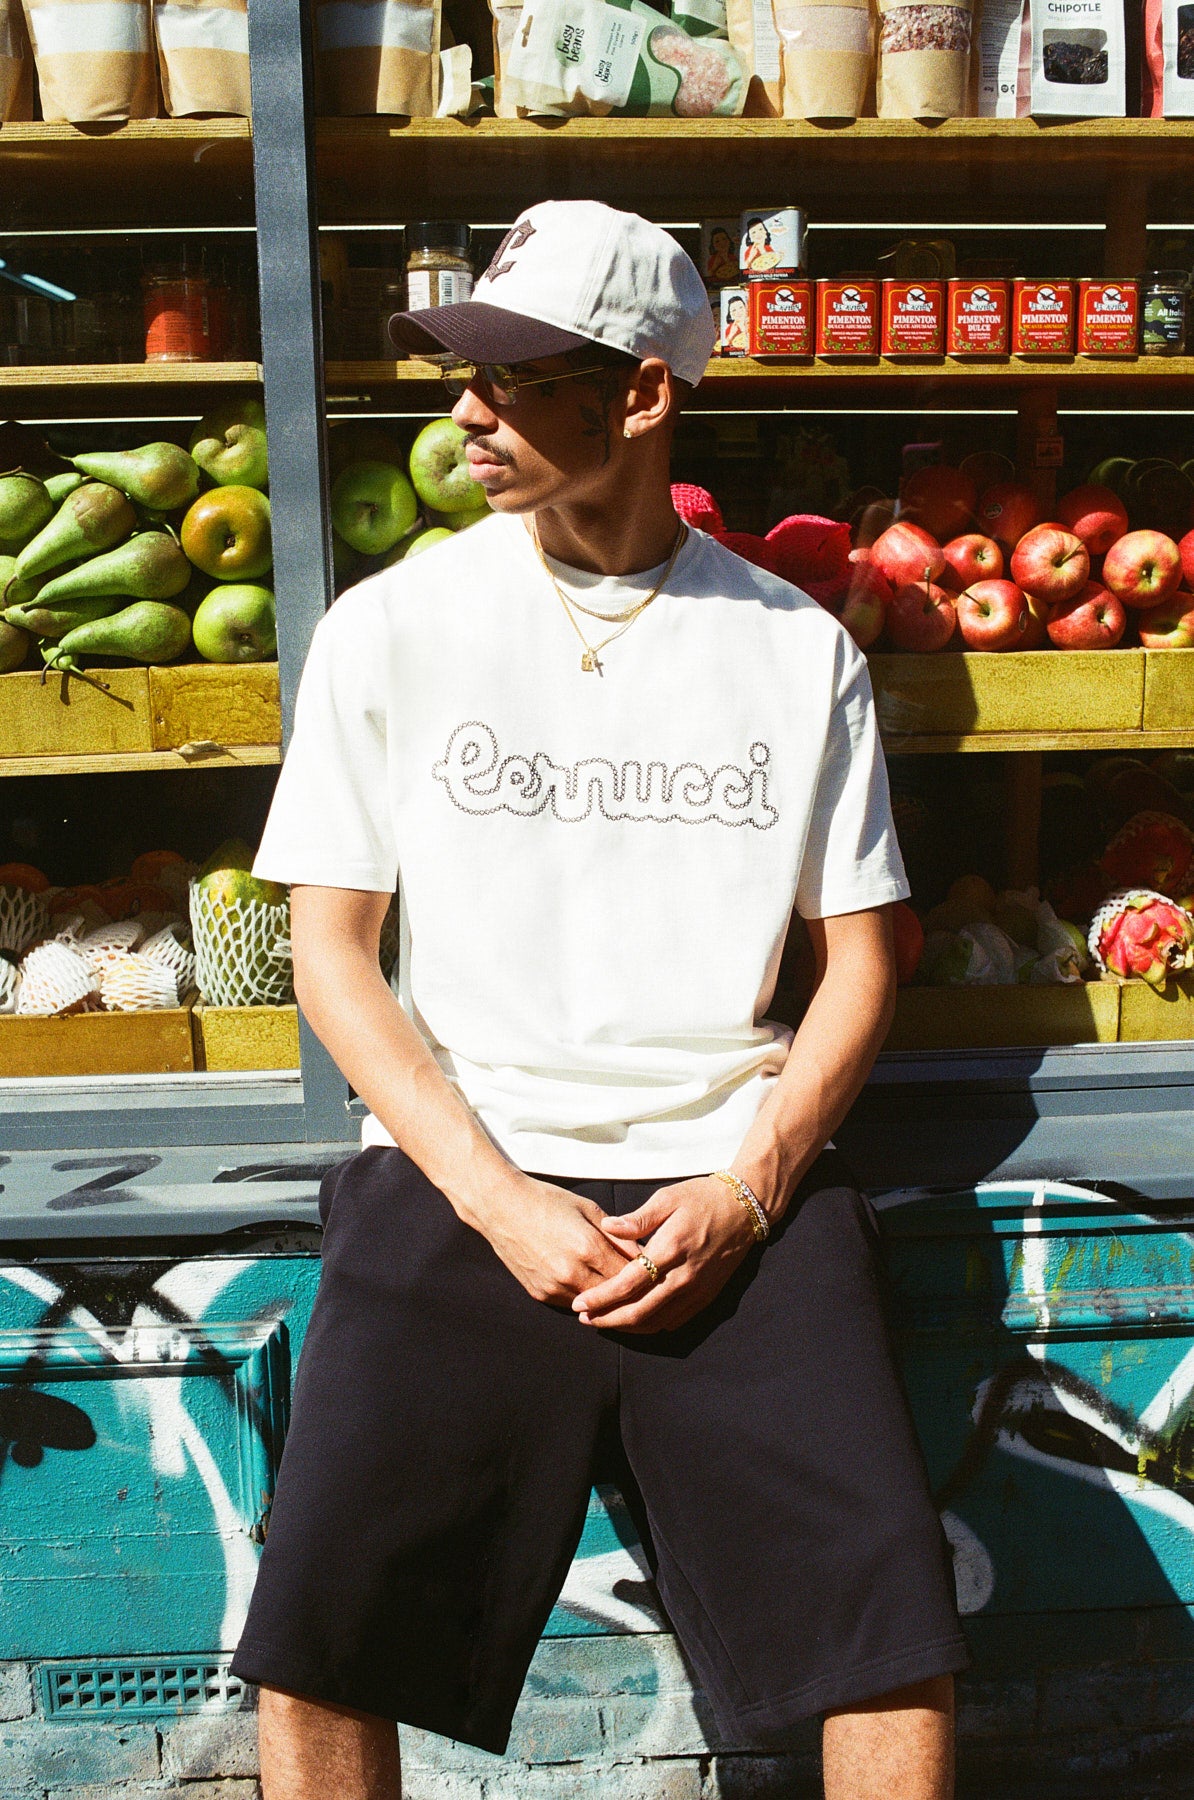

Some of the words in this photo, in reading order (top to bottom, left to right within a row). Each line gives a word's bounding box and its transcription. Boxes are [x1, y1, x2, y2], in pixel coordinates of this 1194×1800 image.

[1048, 3, 1101, 13] CHIPOTLE
[557, 24, 575, 54] busy
[566, 28, 585, 62] beans
[761, 315, 806, 325] PIMENTON
[827, 315, 872, 324] PIMENTON
[893, 315, 937, 324] PIMENTON
[957, 315, 1001, 324] PIMENTON
[1021, 314, 1068, 324] PIMENTON
[1086, 314, 1133, 324] PIMENTON
[967, 324, 991, 332] DULCE
[432, 720, 779, 830] Cernucci
